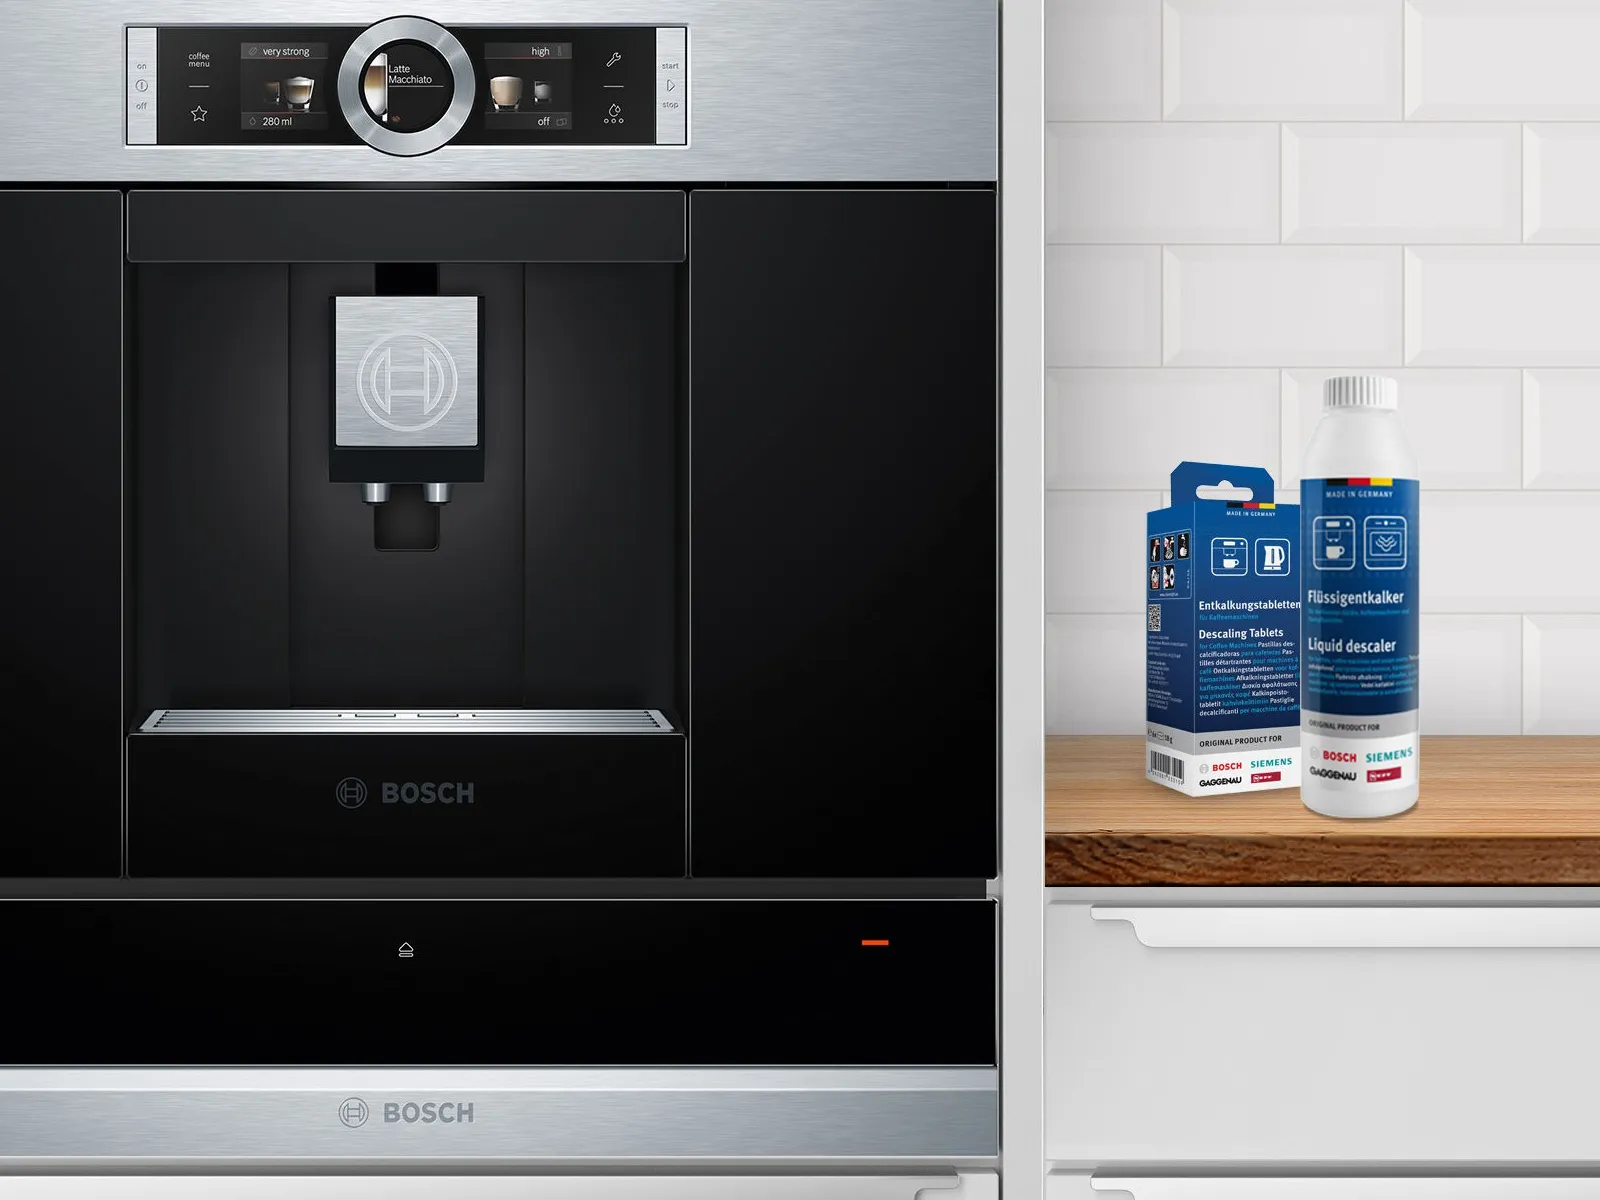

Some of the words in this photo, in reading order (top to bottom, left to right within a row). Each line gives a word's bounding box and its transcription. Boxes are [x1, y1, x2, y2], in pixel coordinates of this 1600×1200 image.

[188, 52, 210, 61] coffee
[263, 49, 281, 58] very
[282, 48, 310, 58] strong
[531, 47, 550, 57] high
[188, 60, 210, 68] menu
[662, 61, 680, 70] start
[388, 65, 411, 74] Latte
[388, 75, 433, 84] Macchiato
[136, 102, 148, 110] off
[662, 100, 679, 109] stop
[263, 117, 280, 126] 280
[281, 116, 292, 126] ml
[537, 117, 550, 126] off
[1307, 590, 1405, 608] Flüssigentkalker
[1199, 600, 1301, 611] Entkalkungstabletten
[1199, 628, 1248, 640] Descaling
[1249, 627, 1284, 638] Tablets
[1308, 637, 1343, 655] Liquid
[1345, 638, 1397, 654] descaler
[1199, 708, 1239, 716] decalcificanti
[1308, 719, 1337, 730] ORIGINAL
[1337, 723, 1367, 731] PRODUCT
[1367, 723, 1381, 731] FOR
[1199, 739, 1234, 748] ORIGINAL
[1234, 735, 1268, 744] PRODUCT
[1322, 750, 1357, 763] BOSCH
[1365, 746, 1413, 763] SIEMENS
[1212, 762, 1242, 772] BOSCH
[1250, 757, 1293, 769] SIEMENS
[1309, 766, 1357, 781] GAGGENAU
[1199, 776, 1243, 787] GAGGENAU
[381, 781, 475, 804] BOSCH
[383, 1102, 474, 1123] BOSCH
